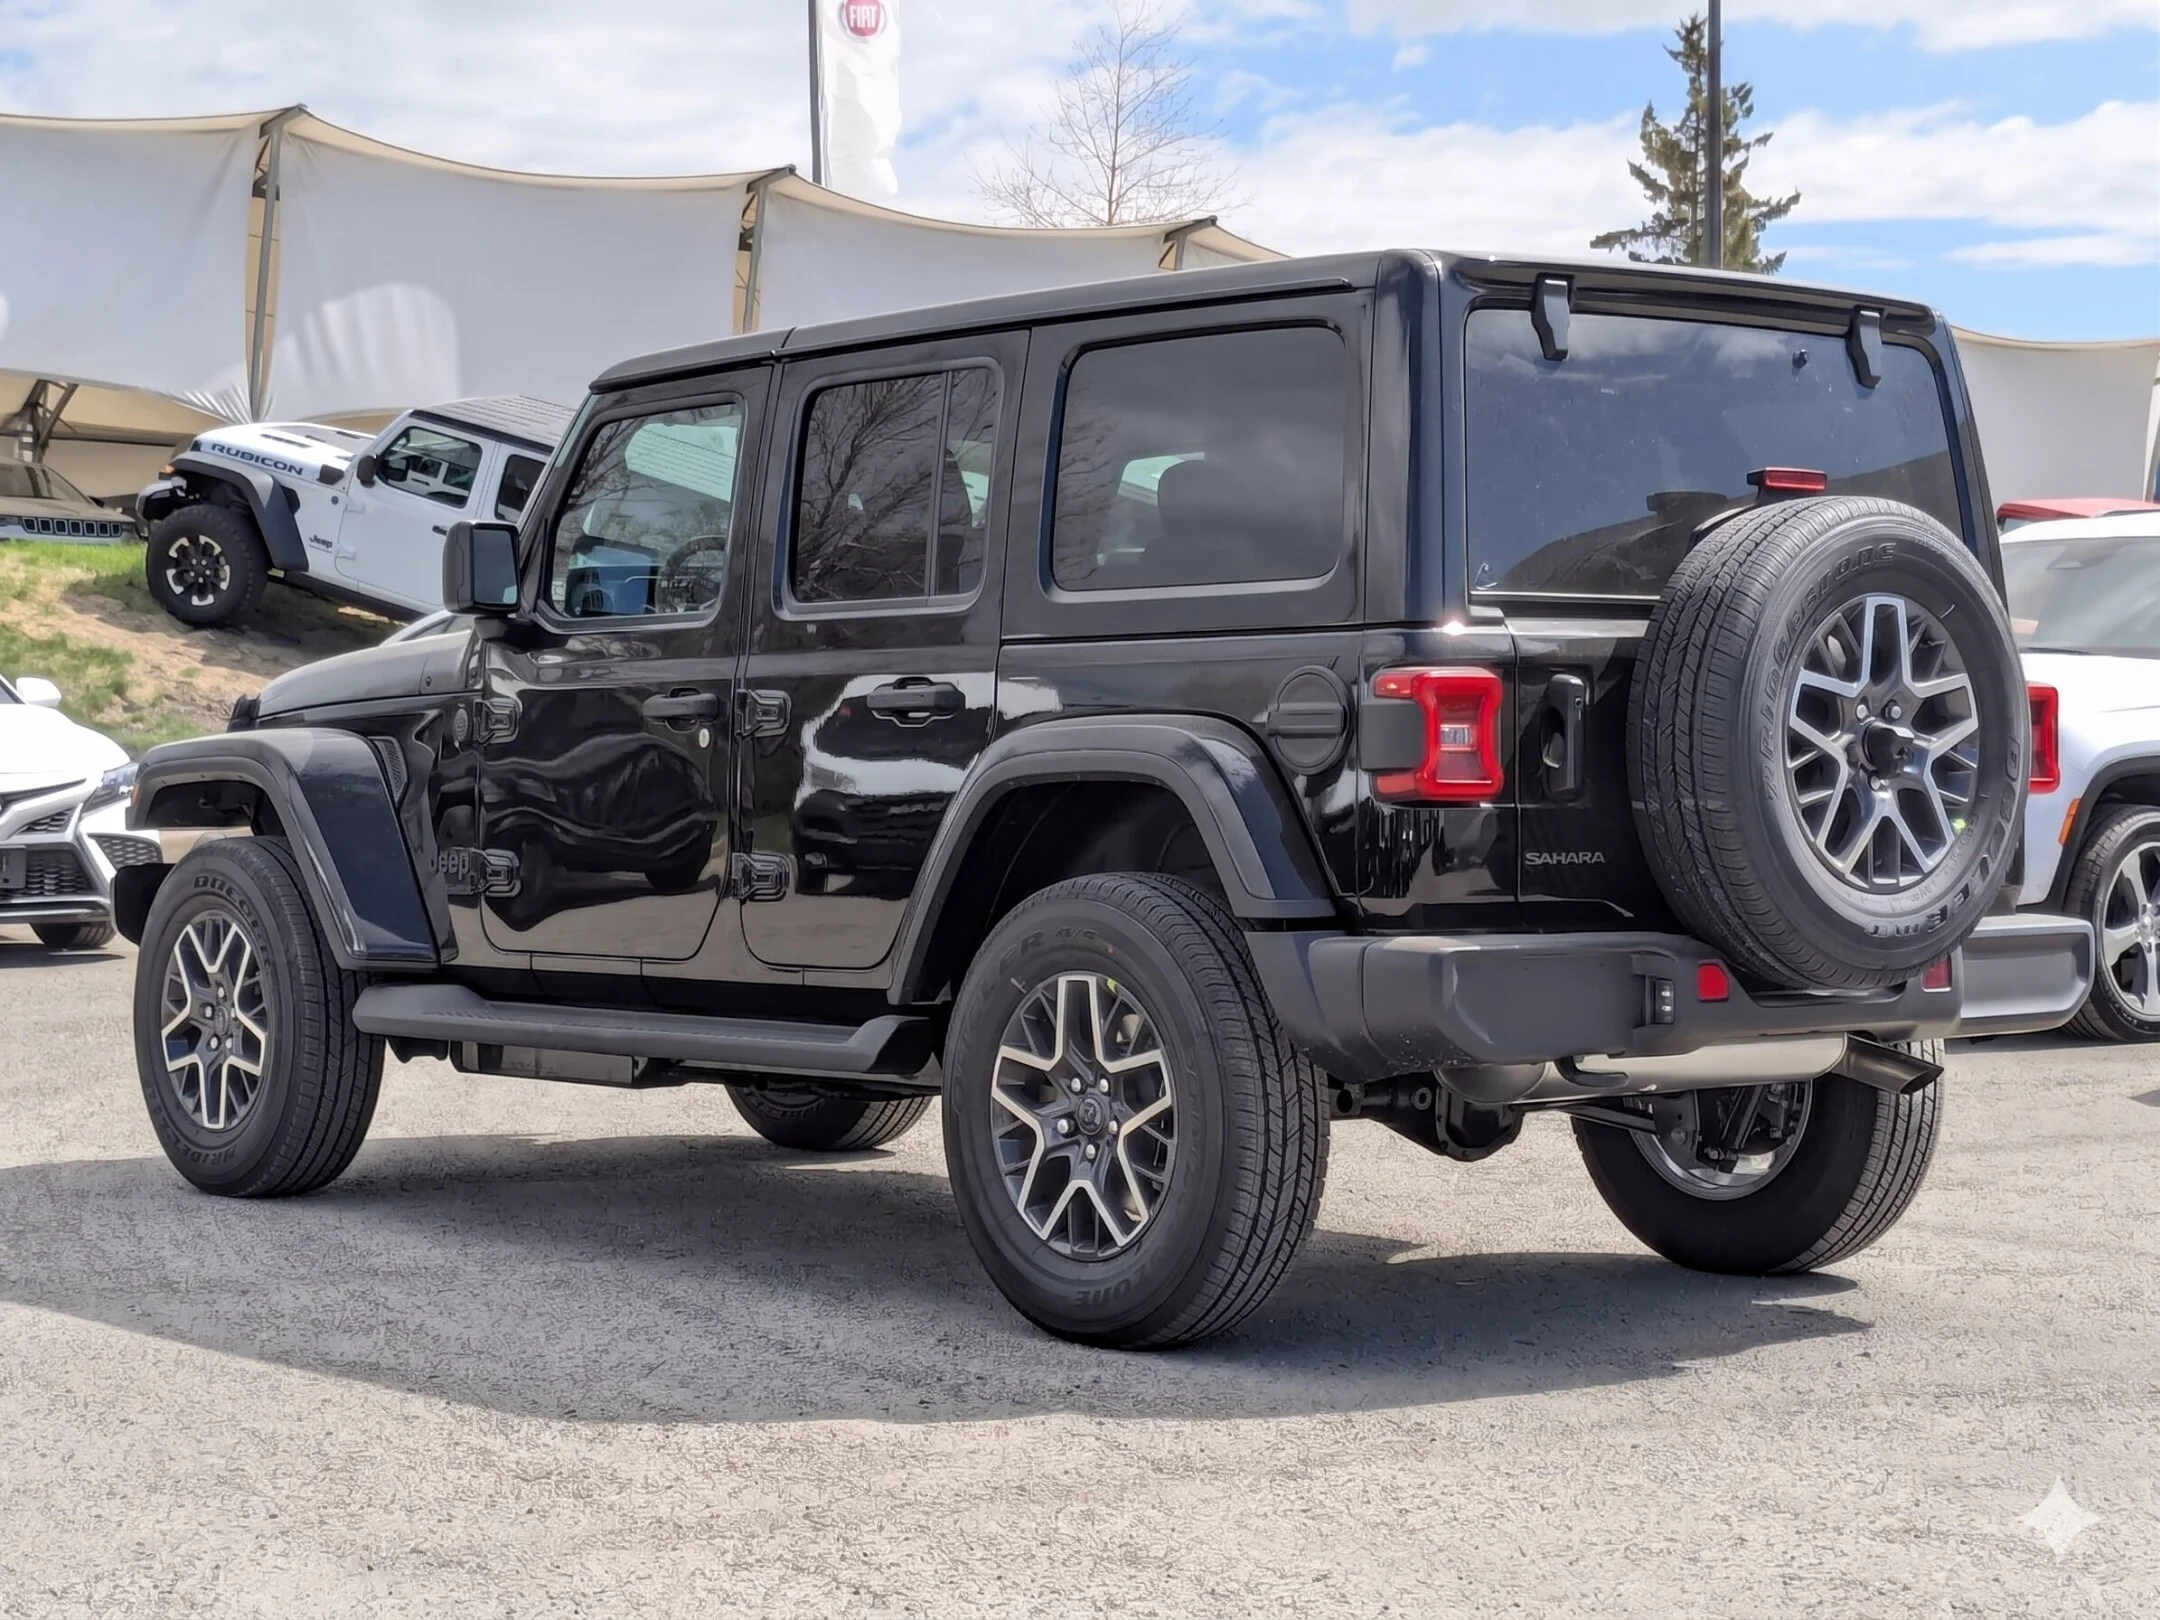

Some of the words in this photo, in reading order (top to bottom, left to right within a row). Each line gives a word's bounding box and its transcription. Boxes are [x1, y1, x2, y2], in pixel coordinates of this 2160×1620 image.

[850, 4, 879, 28] FIAT
[210, 443, 304, 476] RUBICON
[309, 534, 333, 549] Jeep
[1524, 851, 1606, 865] SAHARA
